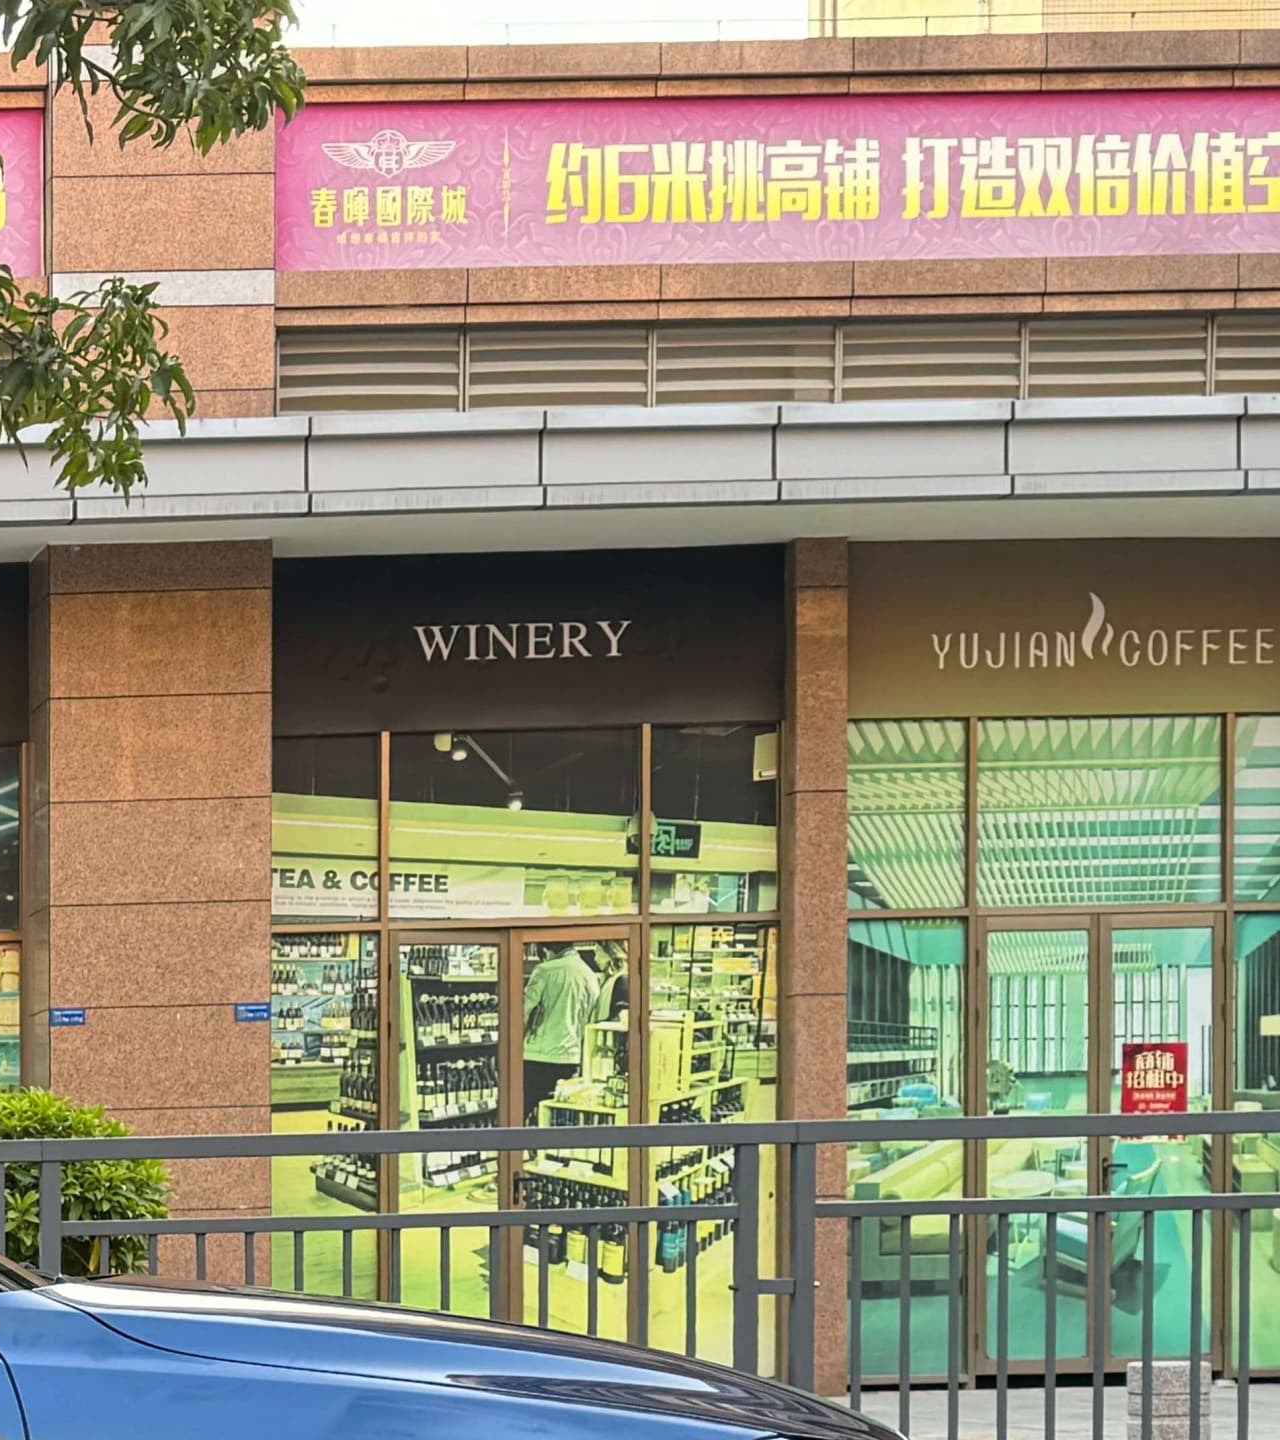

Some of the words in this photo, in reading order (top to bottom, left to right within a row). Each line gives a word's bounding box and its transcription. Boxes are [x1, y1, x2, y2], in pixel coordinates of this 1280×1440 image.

[545, 138, 880, 225] 约6米挑高铺
[414, 619, 632, 663] WINERY
[931, 630, 1075, 670] YUJIAN
[1119, 627, 1276, 668] COFFEE
[322, 869, 341, 890] &
[1126, 1069, 1185, 1088] 招租中
